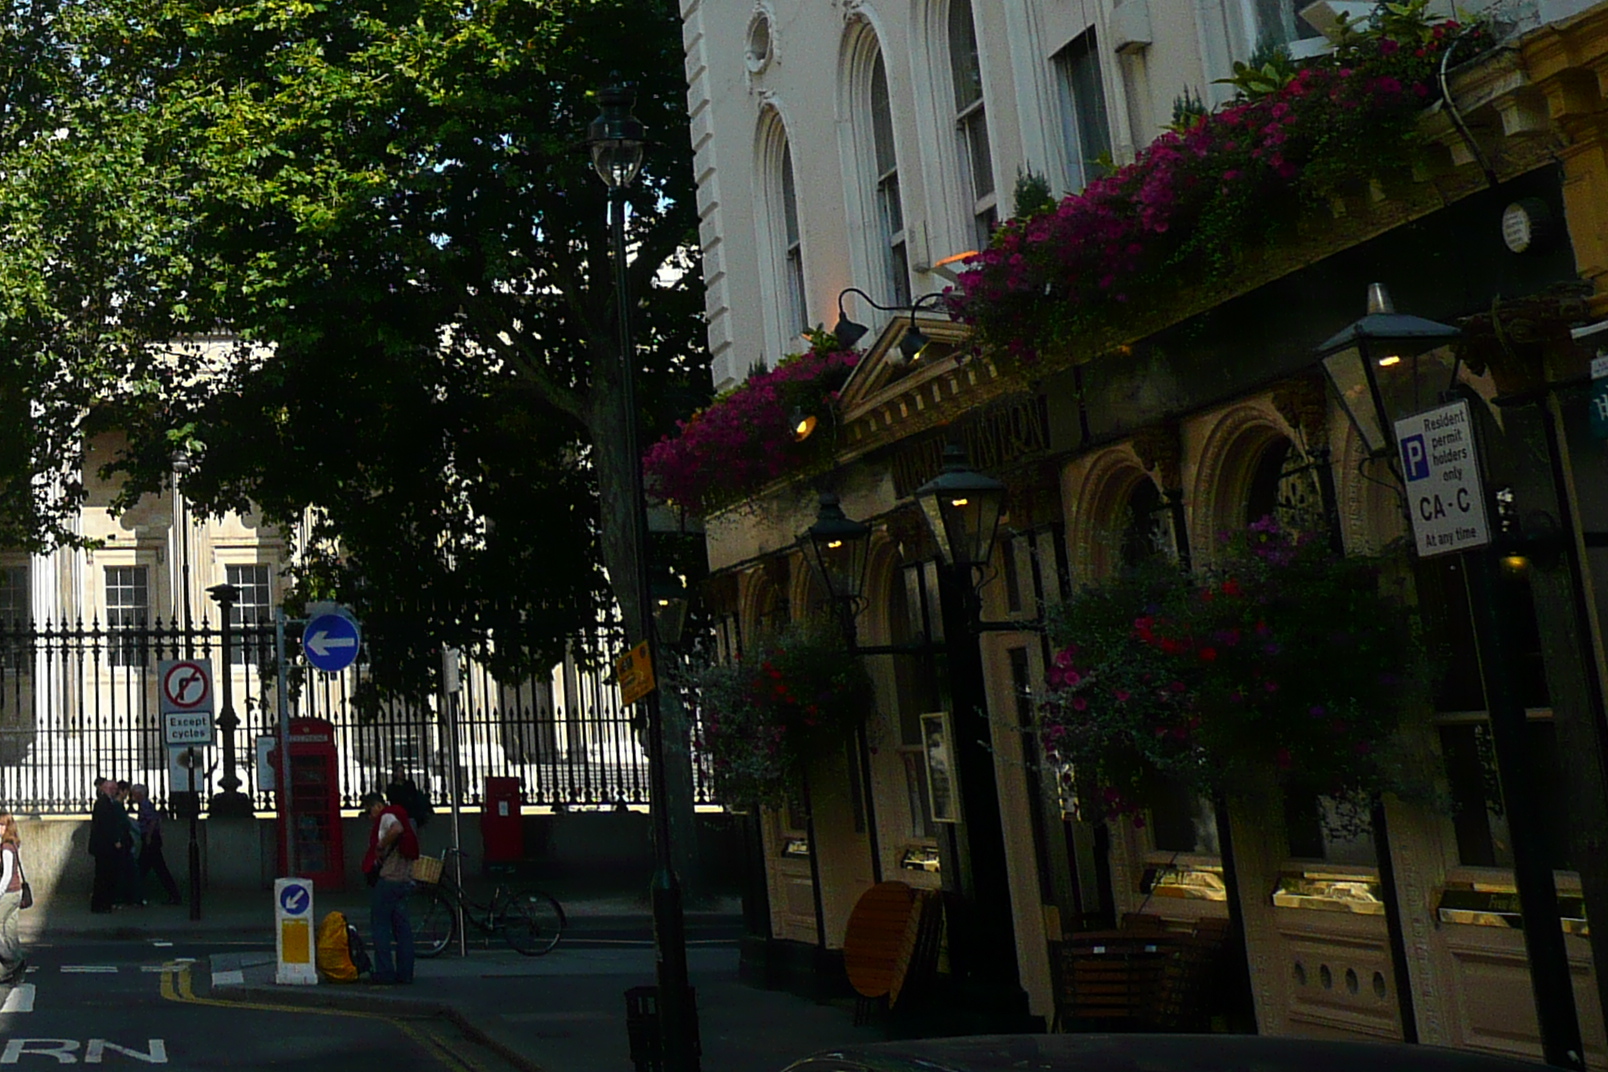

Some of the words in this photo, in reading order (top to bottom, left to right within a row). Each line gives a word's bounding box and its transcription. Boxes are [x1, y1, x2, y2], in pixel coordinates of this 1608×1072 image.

[1423, 410, 1465, 433] Resident
[1431, 429, 1464, 450] permit
[1433, 447, 1468, 466] holders
[1443, 468, 1463, 482] only
[1426, 534, 1437, 548] At
[1438, 532, 1454, 546] any
[1456, 527, 1478, 541] time
[170, 717, 208, 728] Except
[172, 729, 205, 740] cycles
